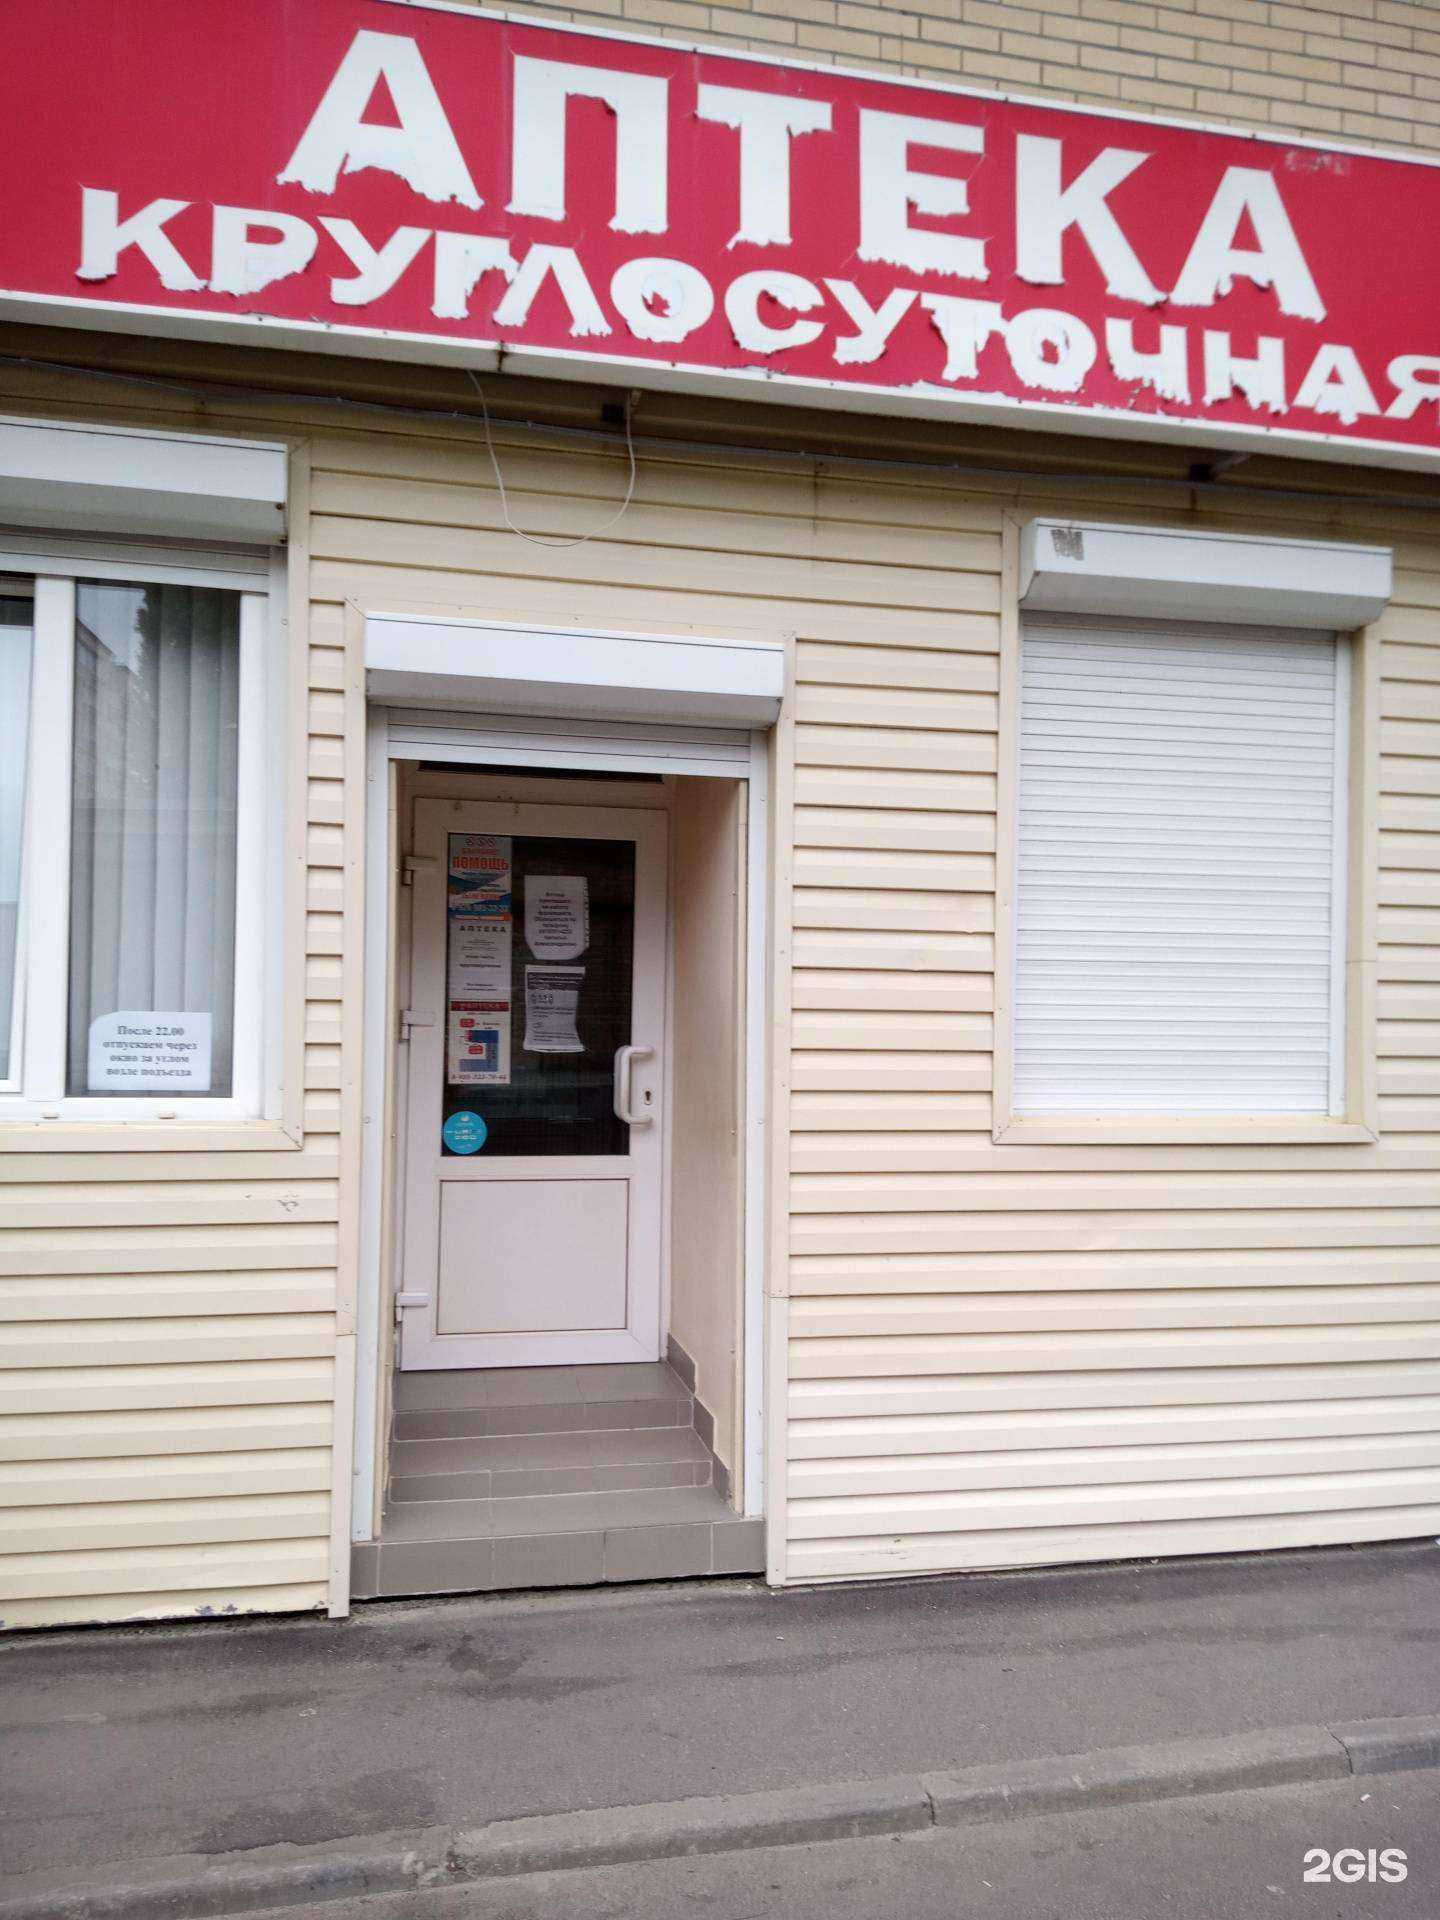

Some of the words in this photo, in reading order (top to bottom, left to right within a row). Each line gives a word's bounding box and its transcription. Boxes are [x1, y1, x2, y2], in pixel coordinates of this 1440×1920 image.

[277, 29, 1327, 323] АПТЕКА
[75, 186, 1440, 425] КРУГЛОСУТОЧНАЯ
[452, 856, 509, 870] ПОМОЩЬ
[459, 925, 506, 933] АПТЕКА
[117, 1025, 152, 1036] После
[155, 1026, 185, 1036] 22.00
[102, 1041, 163, 1050] отпускаем
[166, 1042, 198, 1051] через
[141, 1055, 153, 1063] за
[155, 1055, 190, 1064] углом
